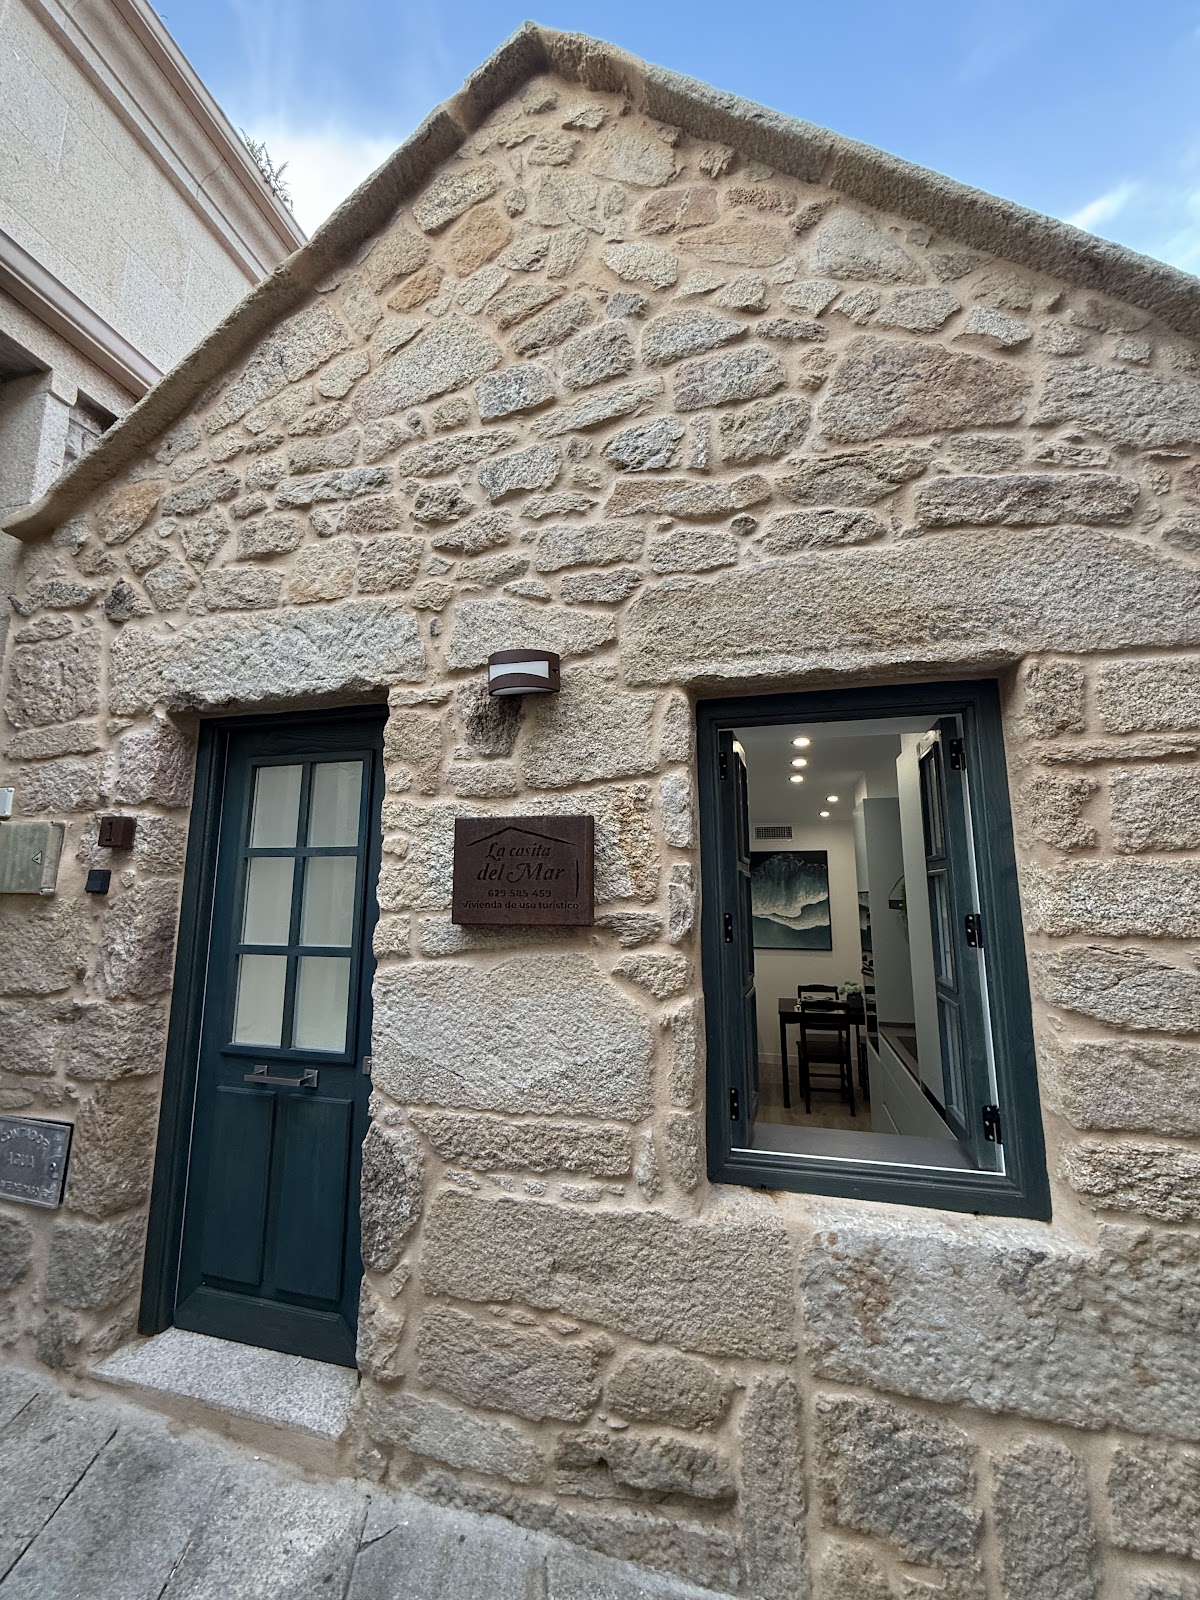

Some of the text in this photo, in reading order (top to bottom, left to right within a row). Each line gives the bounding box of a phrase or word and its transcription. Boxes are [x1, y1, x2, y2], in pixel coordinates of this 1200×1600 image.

[105, 821, 113, 841] 1
[485, 842, 551, 861] La casita
[476, 862, 565, 883] del Mar
[487, 889, 507, 898] 629
[532, 889, 552, 898] 459
[462, 900, 502, 909] Vivienda
[504, 900, 517, 909] de
